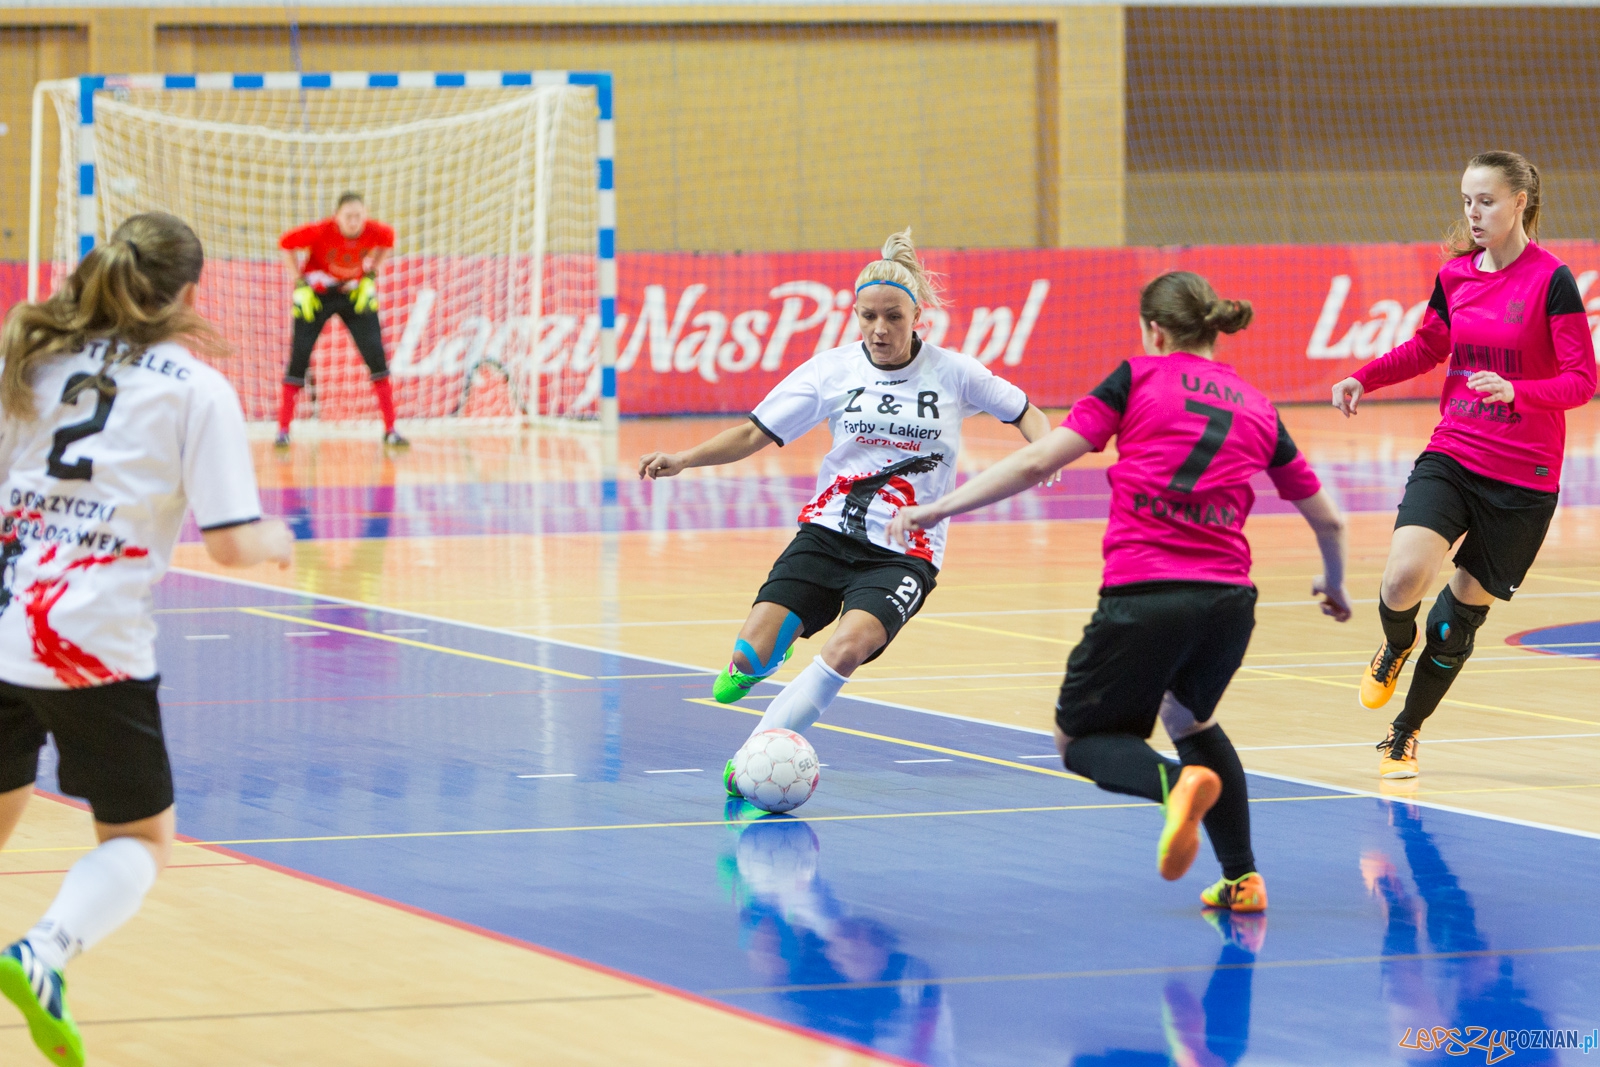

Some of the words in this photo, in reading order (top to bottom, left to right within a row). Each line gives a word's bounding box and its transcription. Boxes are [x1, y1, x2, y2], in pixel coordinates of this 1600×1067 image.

[844, 386, 866, 412] Z
[877, 394, 902, 415] &
[917, 391, 940, 419] R
[1181, 373, 1245, 407] UAM
[1449, 398, 1508, 418] PRIME
[47, 371, 117, 482] 2
[844, 420, 875, 434] Farby
[889, 423, 942, 440] Lakiery
[1167, 398, 1233, 494] 7
[895, 575, 921, 612] 21
